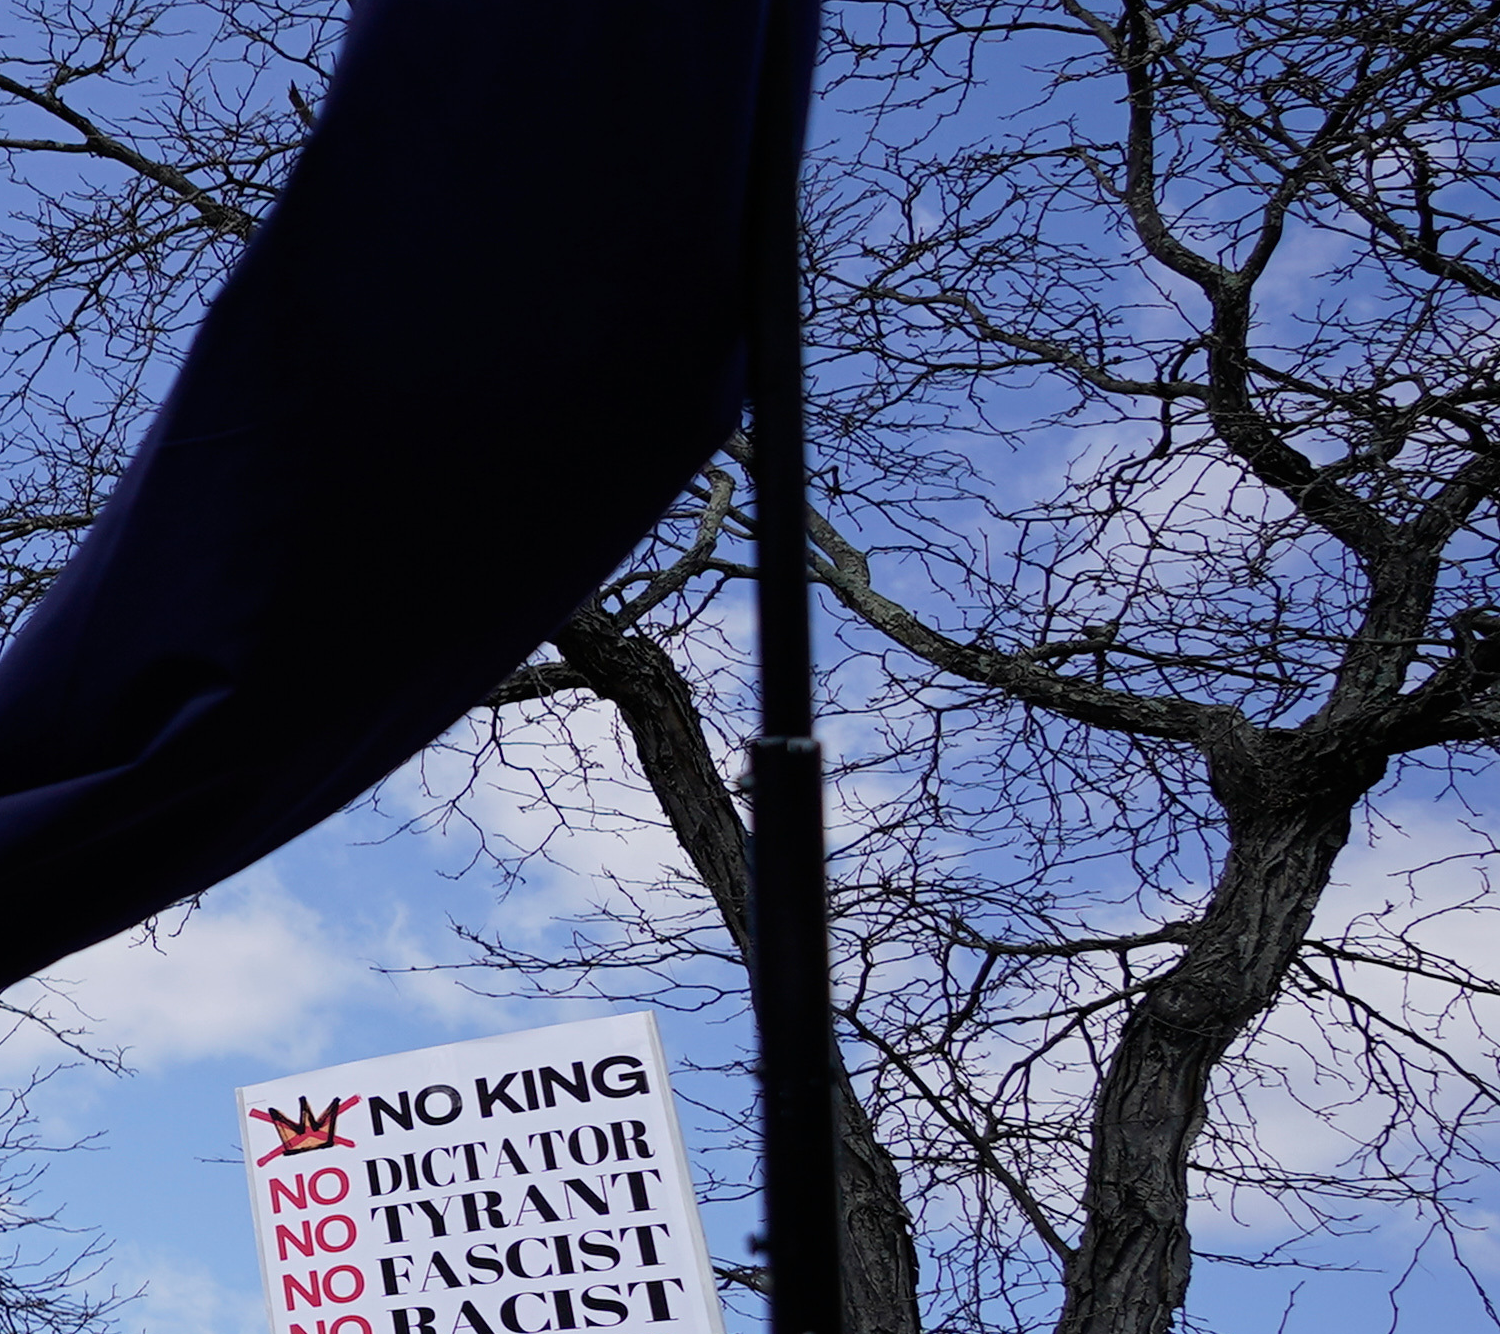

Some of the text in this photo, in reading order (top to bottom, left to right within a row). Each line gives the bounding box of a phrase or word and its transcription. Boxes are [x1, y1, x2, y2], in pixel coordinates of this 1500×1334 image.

[368, 1053, 651, 1137] NO KING
[268, 1119, 656, 1215] NO DICTATOR
[275, 1168, 663, 1262] NO TYRANT
[282, 1223, 671, 1312] NO FASCIST
